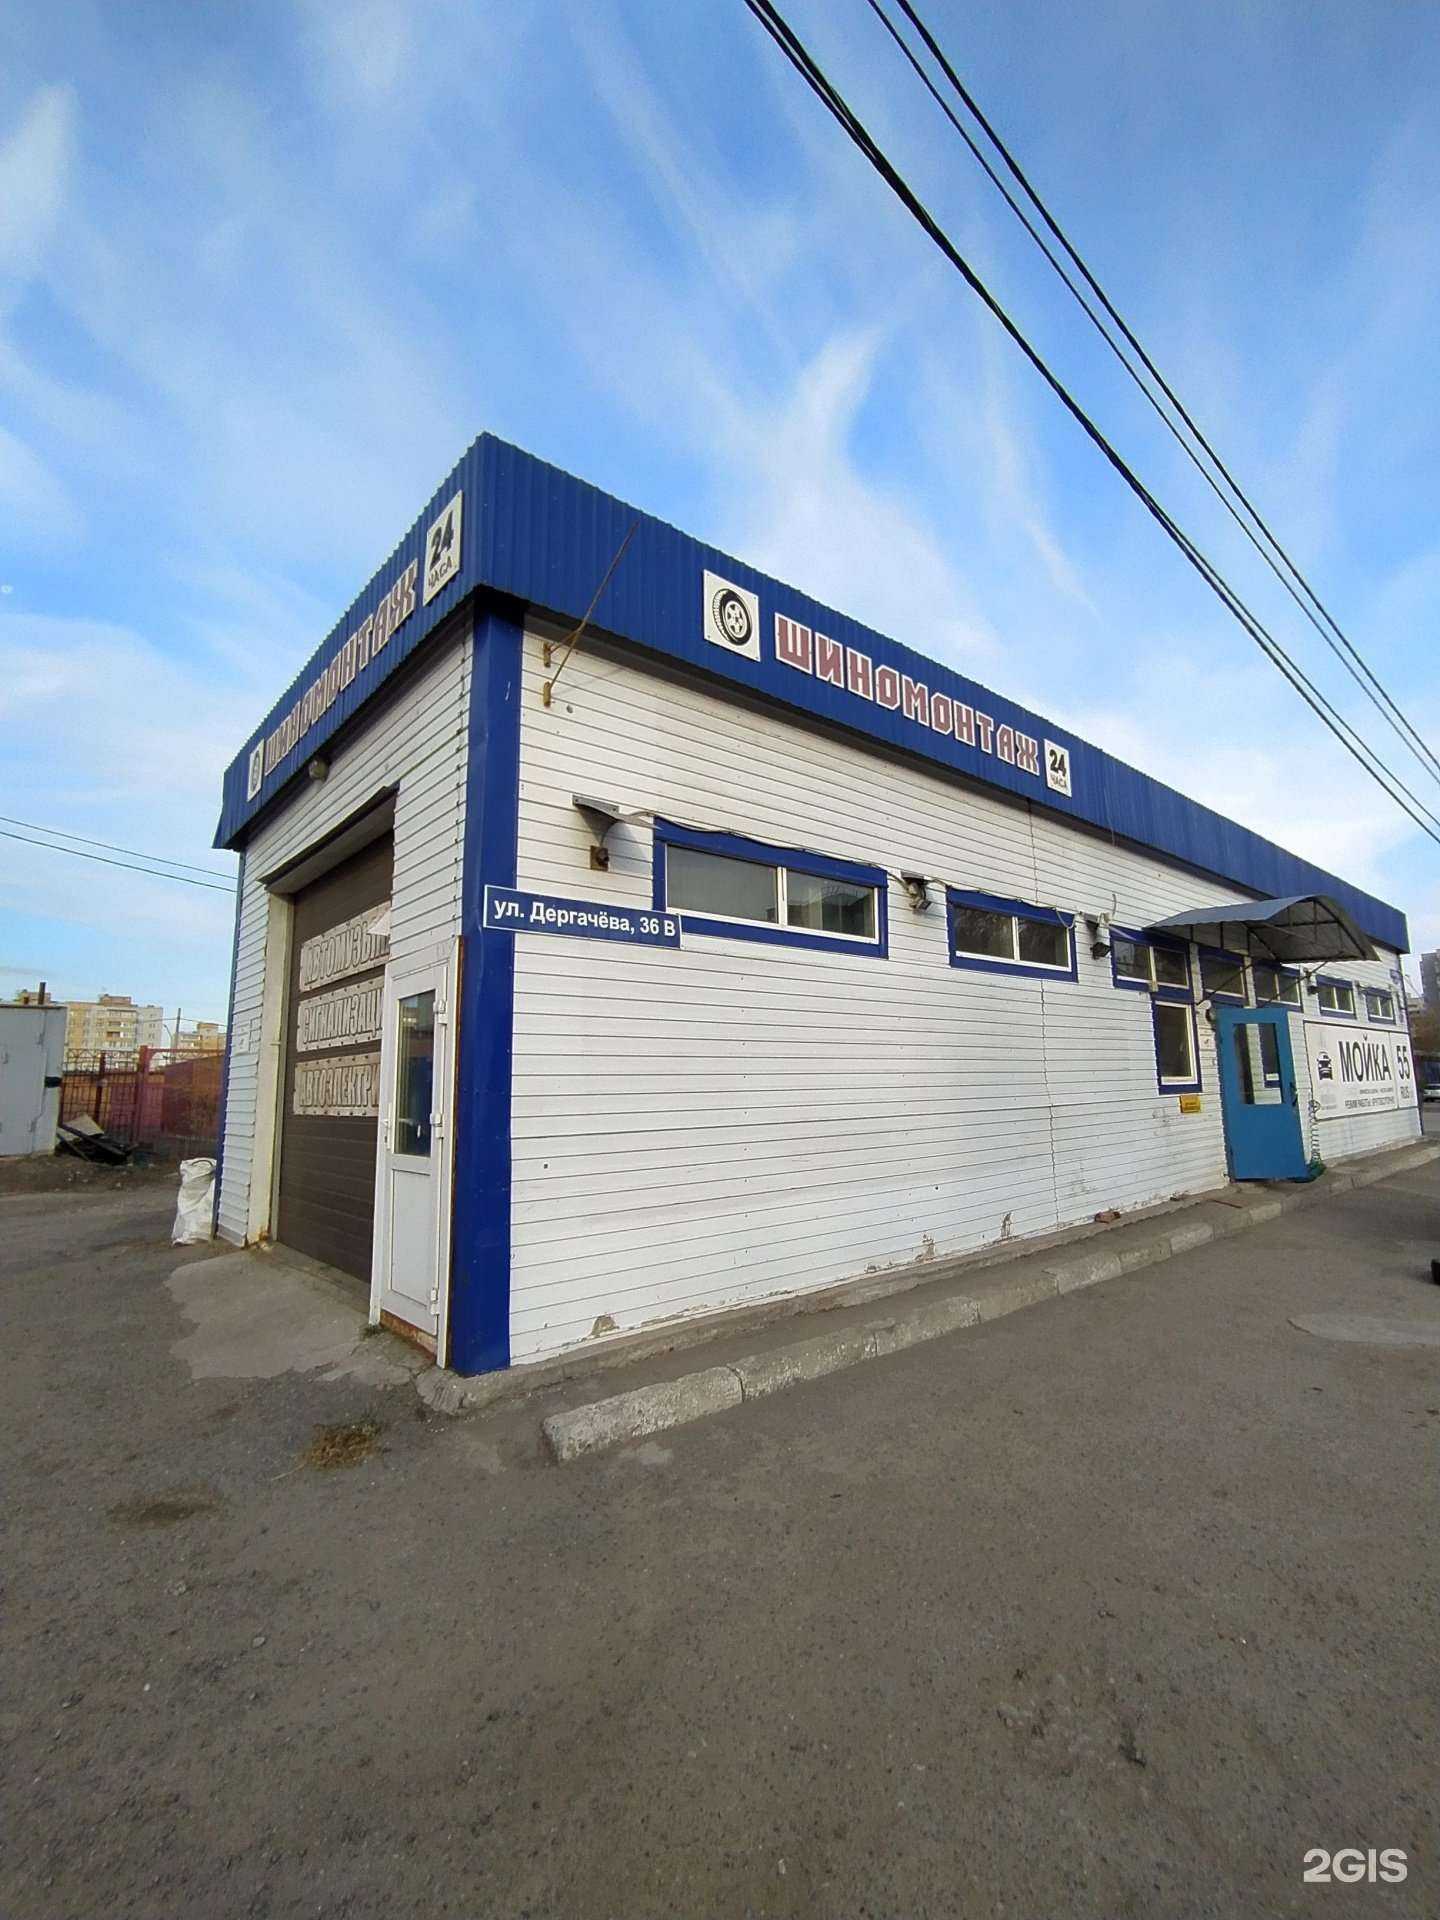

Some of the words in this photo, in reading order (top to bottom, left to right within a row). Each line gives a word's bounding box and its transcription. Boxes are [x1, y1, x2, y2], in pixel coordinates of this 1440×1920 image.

[430, 510, 454, 571] 24
[264, 556, 419, 777] ШИНОМОНТАЖ
[773, 611, 1041, 777] ШИНОМОНТАЖ
[1049, 749, 1067, 777] 24
[493, 900, 525, 919] ул.
[529, 901, 635, 934] Дергачёва,
[639, 917, 660, 935] 36
[663, 920, 677, 937] В
[1338, 1033, 1392, 1082] МОЙКА
[1396, 1045, 1411, 1080] 55
